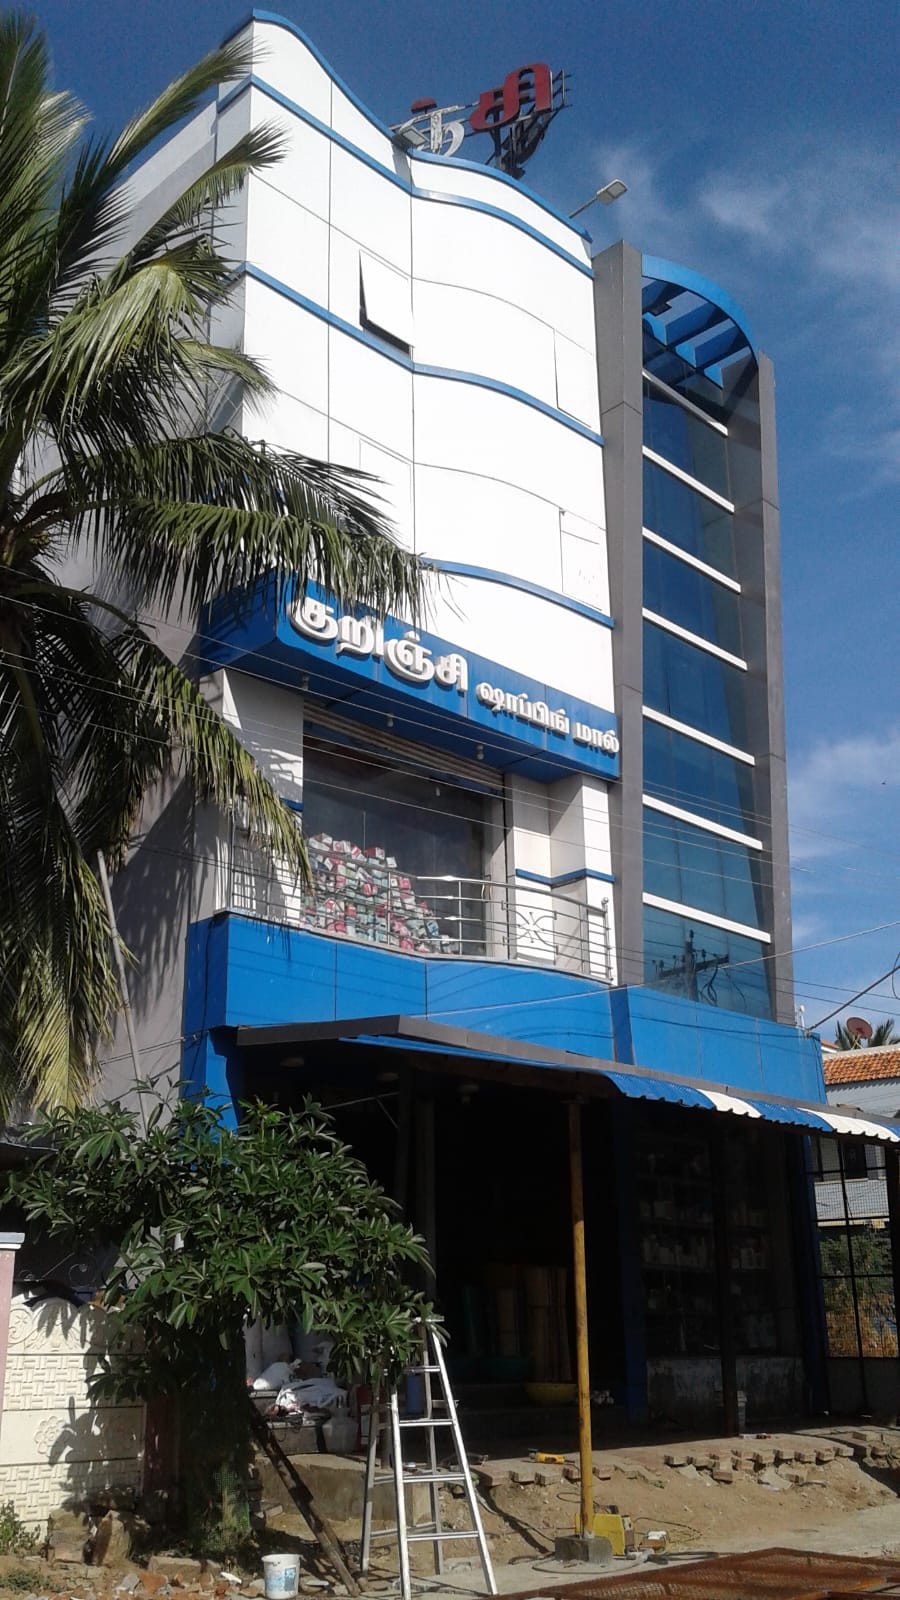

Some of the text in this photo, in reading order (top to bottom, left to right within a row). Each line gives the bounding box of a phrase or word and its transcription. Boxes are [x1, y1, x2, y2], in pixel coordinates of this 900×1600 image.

[287, 597, 619, 753] குறிஞ்சி ஷாப்பிங் மால்
